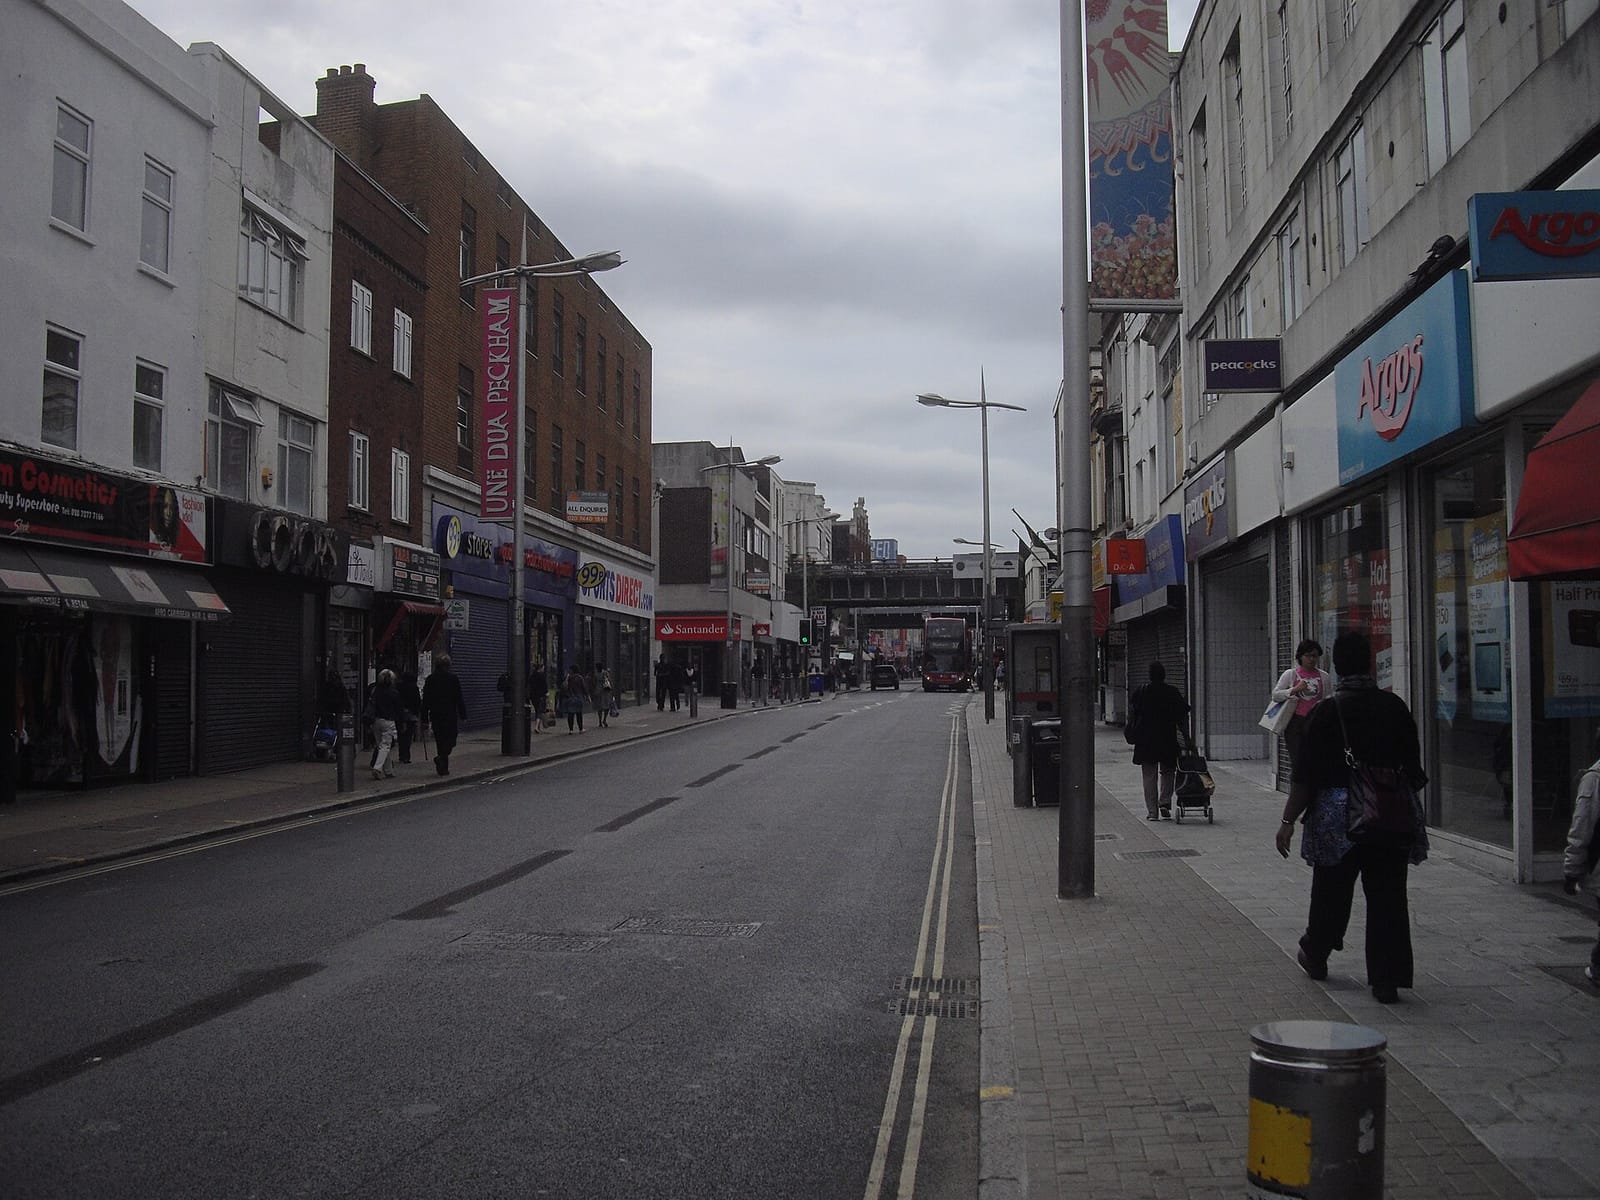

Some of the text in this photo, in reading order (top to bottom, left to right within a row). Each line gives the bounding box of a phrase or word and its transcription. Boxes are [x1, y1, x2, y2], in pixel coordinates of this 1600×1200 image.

[1488, 207, 1600, 257] Argo
[487, 296, 511, 403] PECKHAM
[1211, 360, 1276, 373] peacocks
[1357, 334, 1424, 441] Argos
[487, 410, 509, 461] DUA
[20, 460, 117, 505] Cosmetics
[16, 493, 60, 514] Superstore
[1186, 475, 1225, 535] peacocks
[582, 566, 604, 584] 99p
[1370, 560, 1387, 586] Hot
[1556, 587, 1580, 601] Half
[676, 624, 725, 634] Santander
